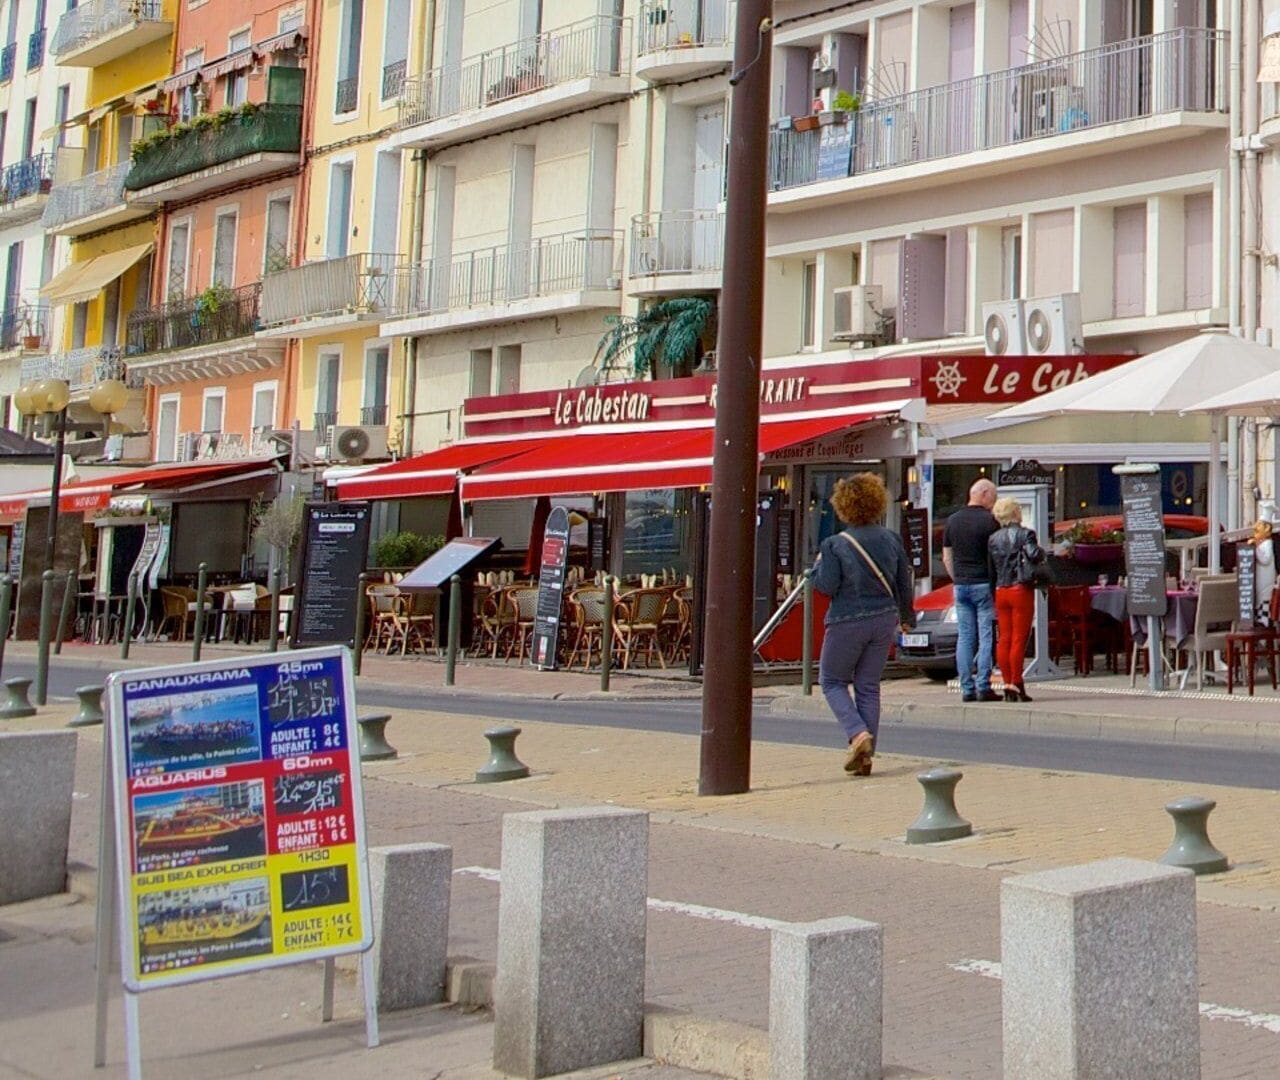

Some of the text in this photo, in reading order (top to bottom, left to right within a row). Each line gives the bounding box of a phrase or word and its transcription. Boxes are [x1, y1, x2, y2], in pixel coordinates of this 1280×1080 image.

[983, 362, 1089, 394] Le Cab
[709, 376, 805, 408] RRANT
[554, 387, 649, 425] Le Cabestan
[126, 668, 251, 693] CANAUXRAMA
[277, 661, 324, 675] 45mn
[283, 756, 333, 771] 60mn
[132, 767, 227, 789] AQUARIUS
[298, 849, 330, 863] 1H30
[137, 860, 267, 886] SUB SEA EXPLORER
